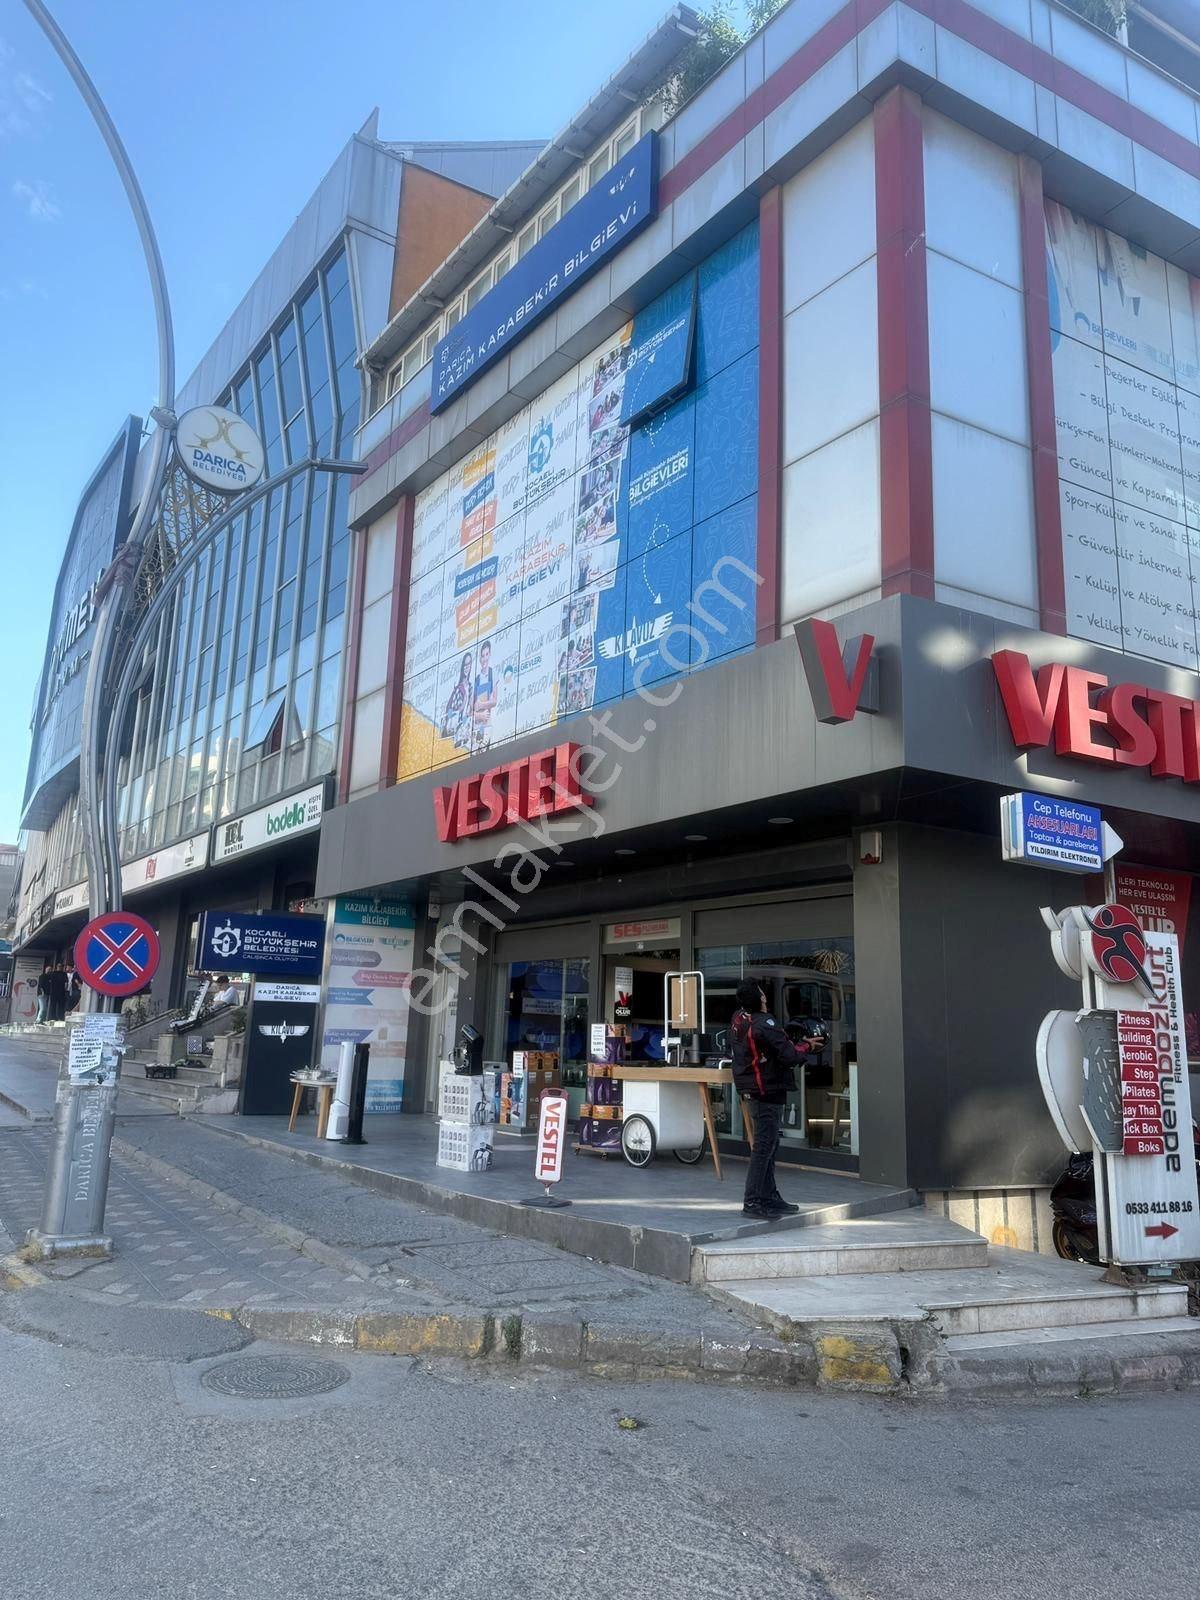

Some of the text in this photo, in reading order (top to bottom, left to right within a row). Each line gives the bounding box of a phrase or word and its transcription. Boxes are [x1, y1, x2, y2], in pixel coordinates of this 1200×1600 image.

[439, 353, 475, 396] KAZIM
[1105, 365, 1148, 392] Değerler
[1090, 394, 1117, 416] Bilgi
[1121, 405, 1156, 430] Destek
[193, 449, 246, 476] DARICA
[1069, 457, 1111, 482] Güncel
[1116, 477, 1129, 489] ve
[1133, 519, 1146, 530] ve
[1149, 521, 1178, 541] Sanat
[1078, 534, 1134, 562] Güvenilir
[1187, 572, 1198, 584] ve
[1085, 575, 1118, 601] Kulüp
[1122, 588, 1135, 600] ve
[1138, 591, 1172, 615] Atölye
[1087, 613, 1131, 637] Velilere
[1134, 624, 1179, 650] Yönelik
[433, 741, 594, 843] VESTEL
[1033, 799, 1093, 823] Cep Telefonu
[1026, 813, 1098, 841] AKSESUARLARI
[1029, 829, 1055, 845] Toptan
[1056, 835, 1063, 845] &
[1030, 844, 1060, 858] YILDIRIM
[1118, 888, 1133, 896] HER
[1134, 889, 1147, 899] EVE
[1130, 903, 1168, 917] VESTEL'LE
[1163, 946, 1173, 974] Club
[1167, 977, 1178, 1018] Health
[1120, 1013, 1151, 1026] Fitness
[1172, 1034, 1183, 1083] Fitness
[1134, 1067, 1155, 1081] Step
[1126, 1085, 1156, 1098] Pilates
[1138, 1104, 1158, 1117] Thai
[540, 1101, 563, 1177] VESTEL
[1142, 1123, 1159, 1134] Box
[1138, 1141, 1160, 1154] Boks
[1126, 1200, 1193, 1215] 0533 411 88 16
